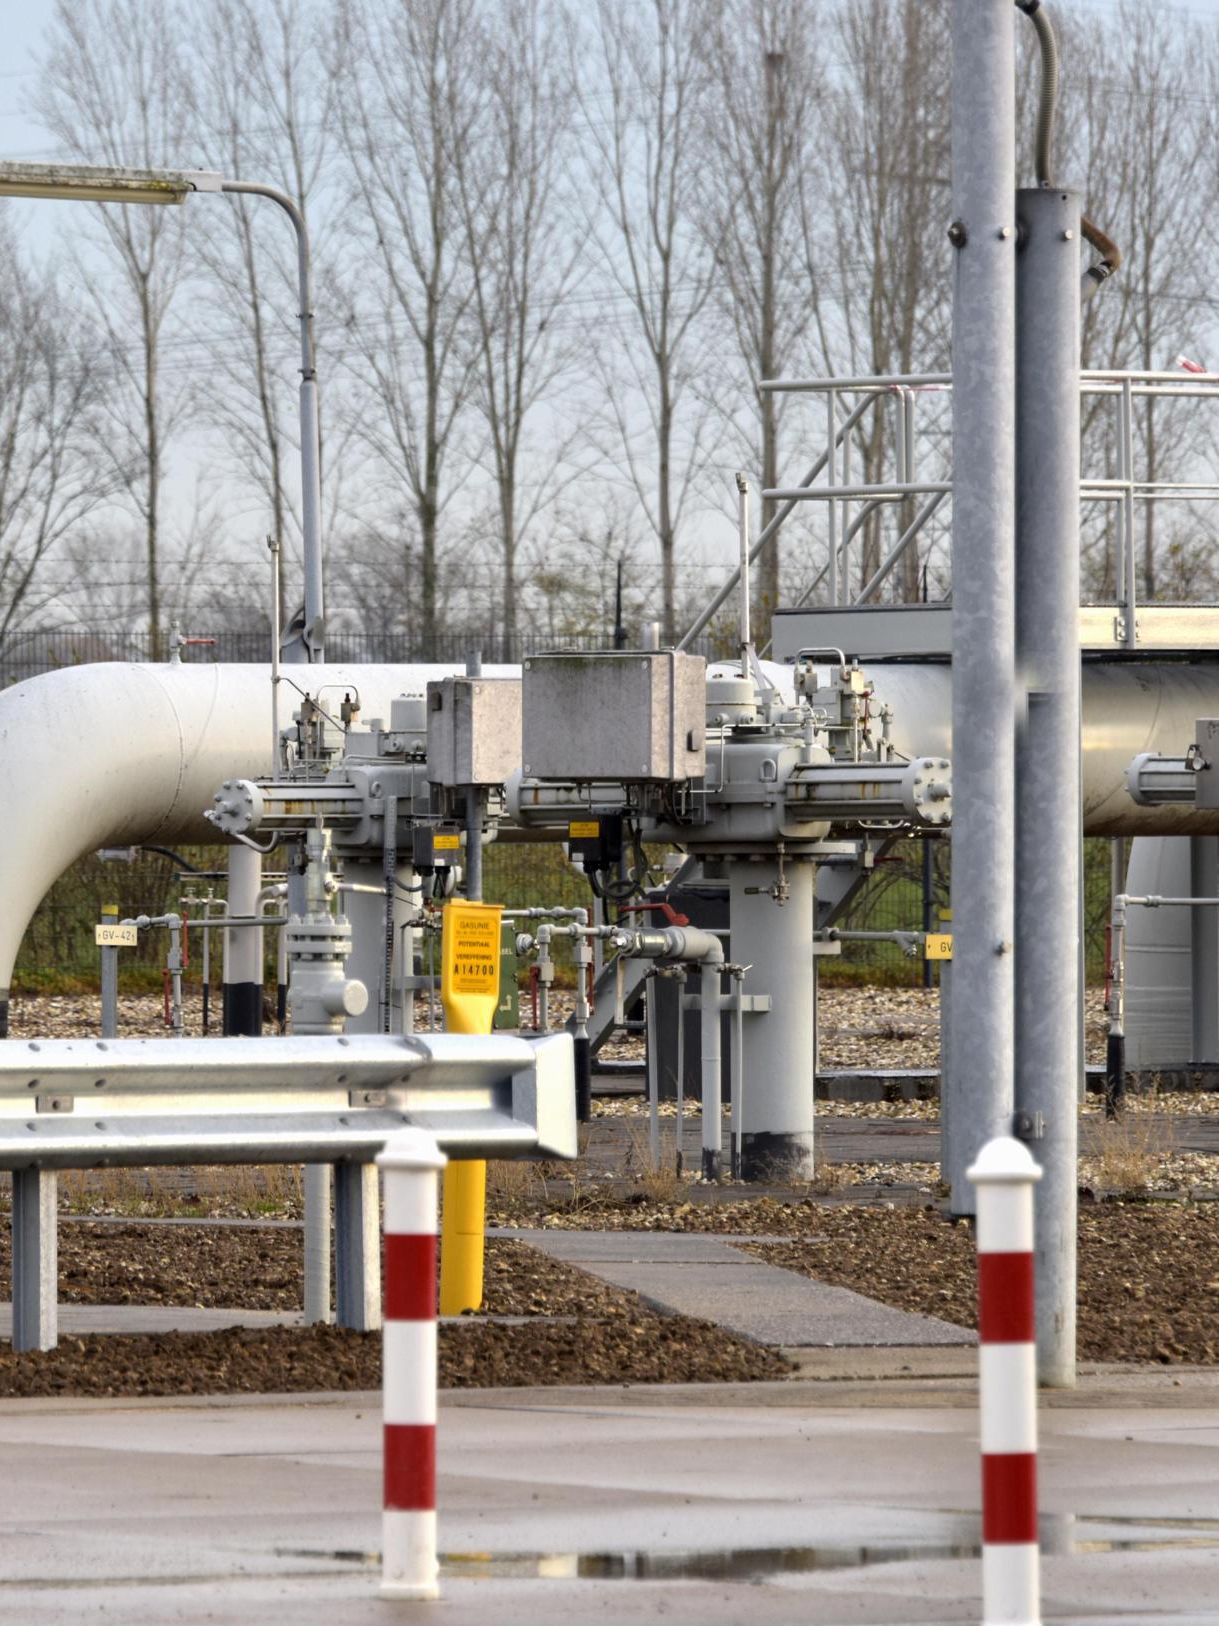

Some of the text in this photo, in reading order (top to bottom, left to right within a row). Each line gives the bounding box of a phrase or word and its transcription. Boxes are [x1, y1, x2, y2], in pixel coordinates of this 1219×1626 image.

[459, 921, 490, 929] GASUNIE
[102, 930, 131, 940] GV-42
[454, 963, 494, 975] A14700
